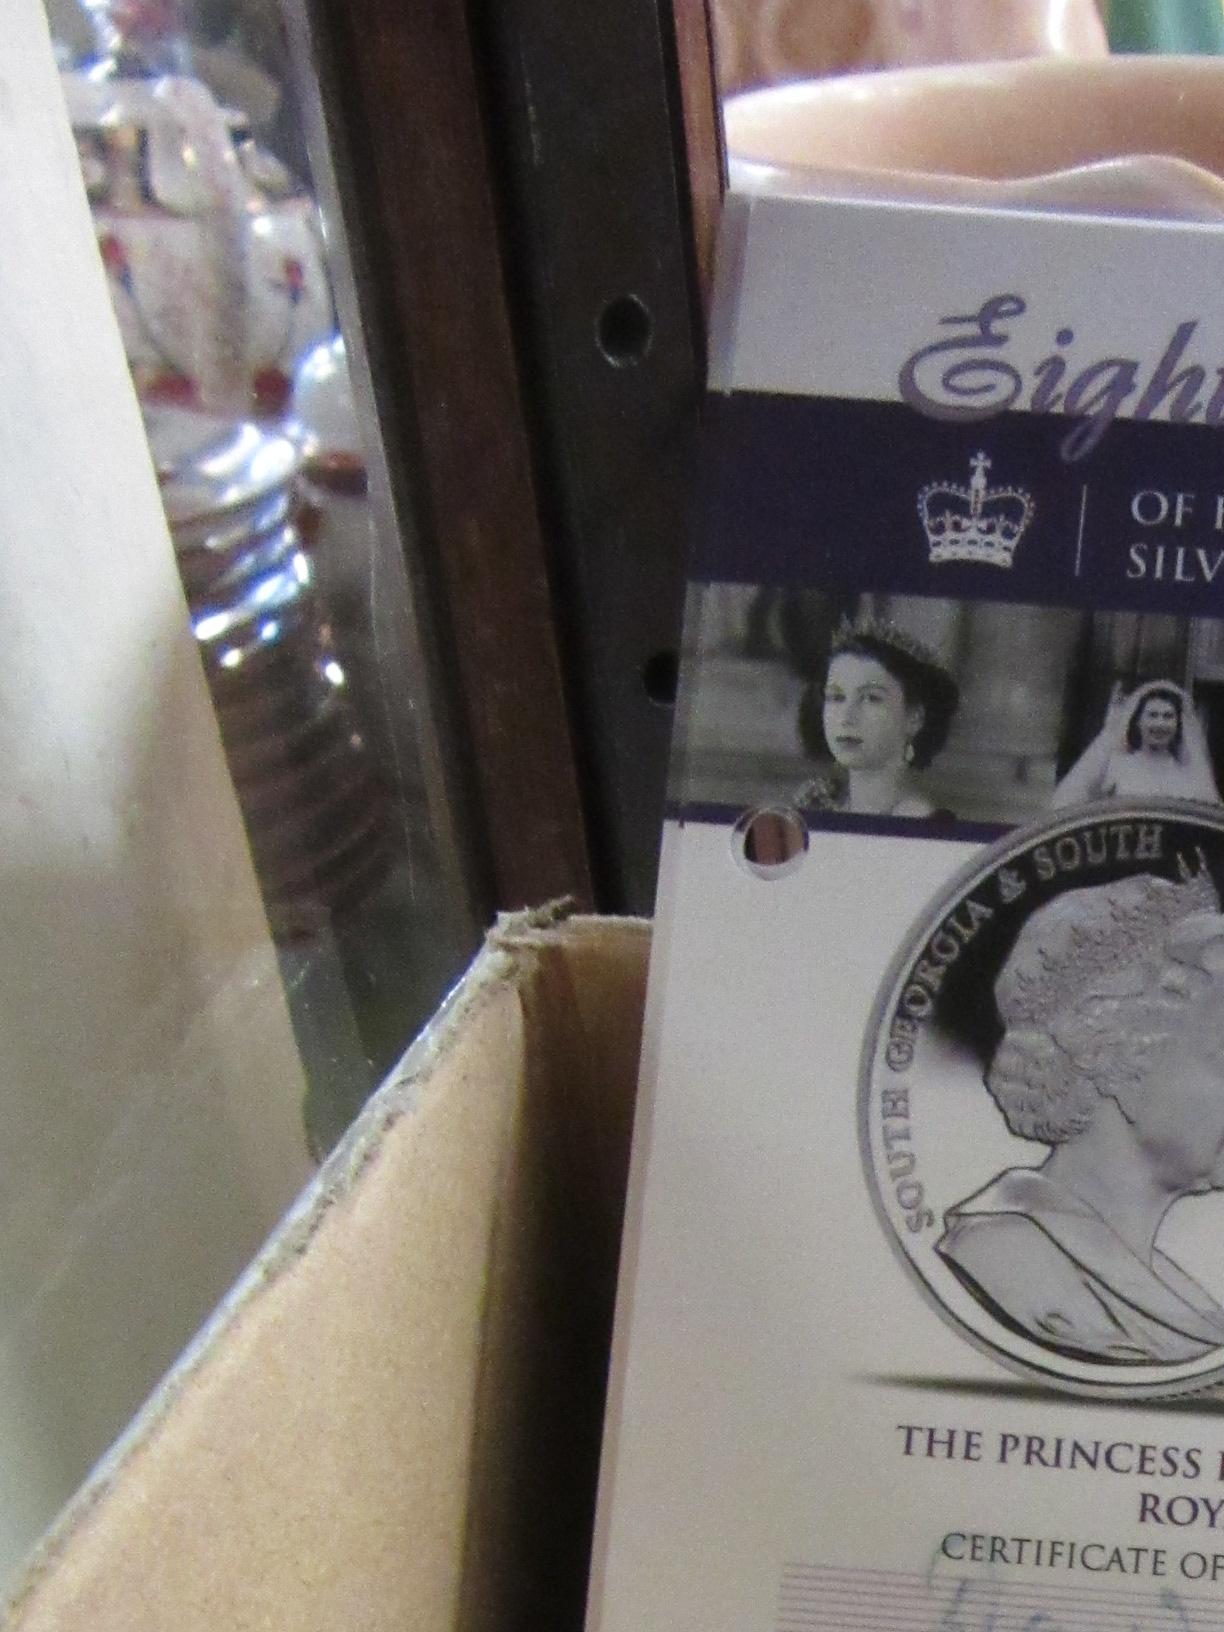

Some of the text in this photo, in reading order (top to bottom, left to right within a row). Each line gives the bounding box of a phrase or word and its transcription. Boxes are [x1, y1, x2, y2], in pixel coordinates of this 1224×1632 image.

[1131, 491, 1193, 531] OF
[1033, 823, 1164, 860] SOUTH
[885, 901, 994, 1073] GEORGIA
[881, 1087, 934, 1235] SOUTH
[896, 1425, 983, 1461] THE
[999, 1432, 1201, 1480] PRINCESS
[941, 1531, 1167, 1578] CERTIFICATE
